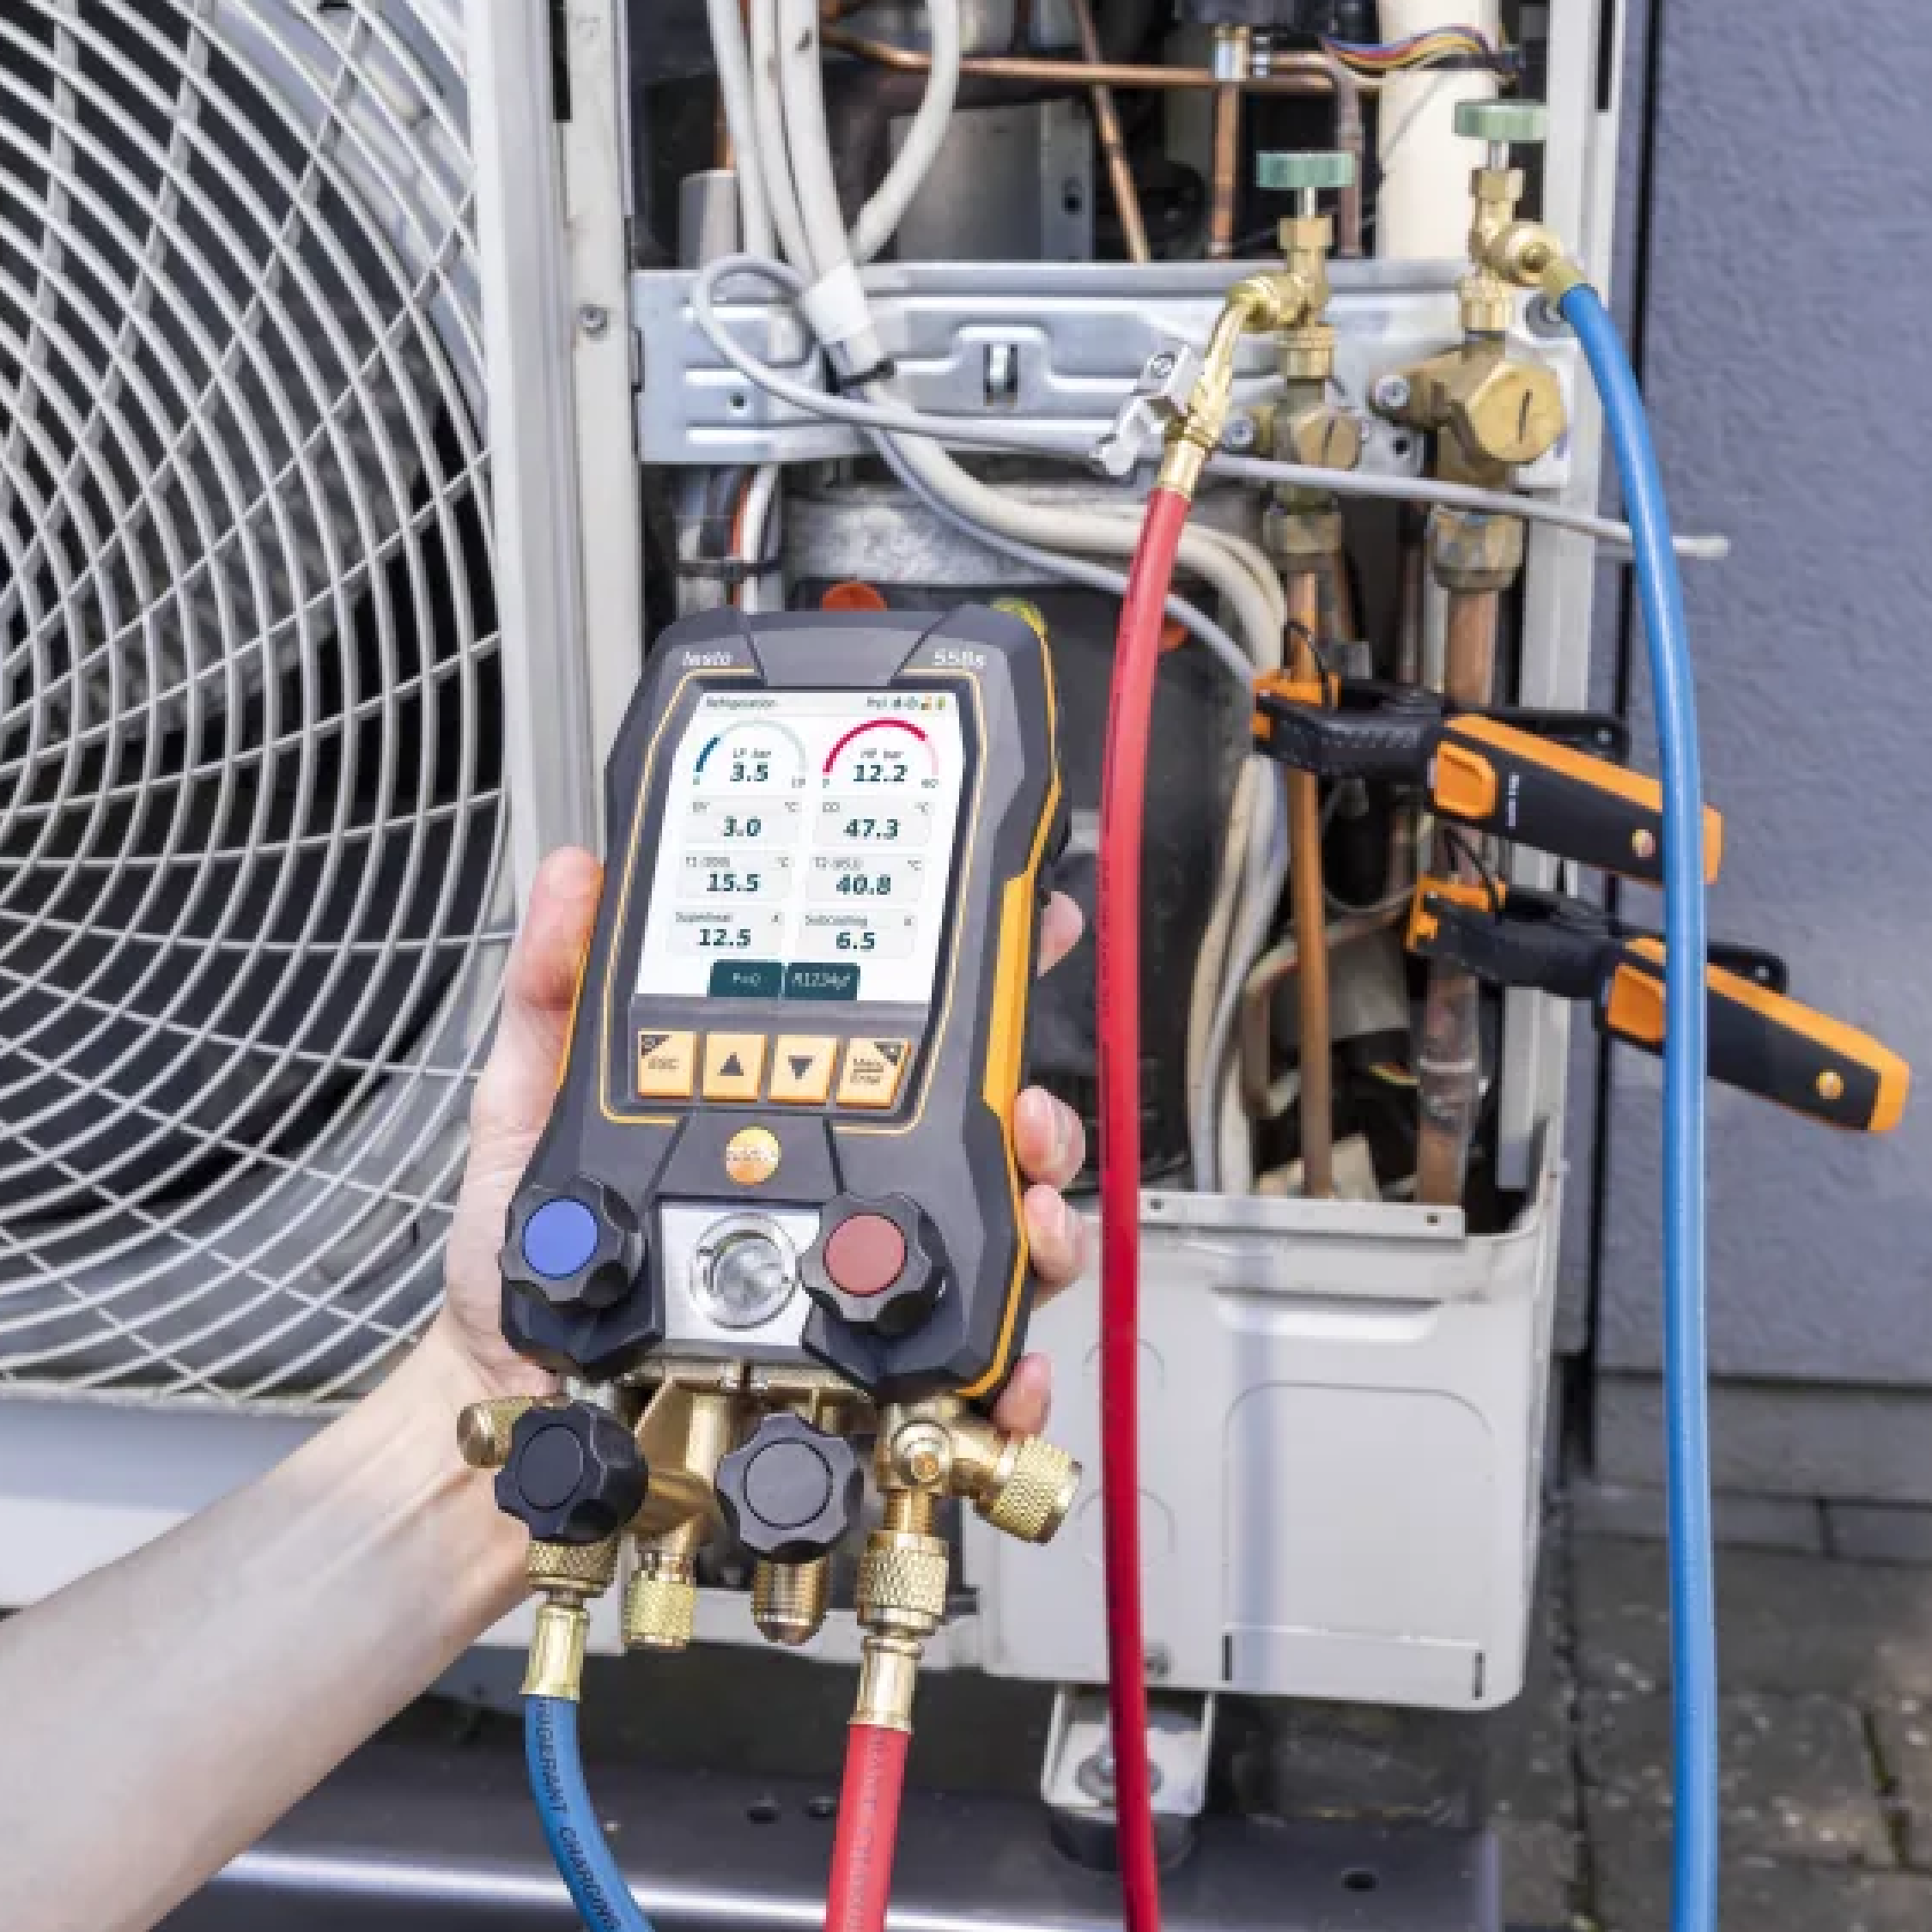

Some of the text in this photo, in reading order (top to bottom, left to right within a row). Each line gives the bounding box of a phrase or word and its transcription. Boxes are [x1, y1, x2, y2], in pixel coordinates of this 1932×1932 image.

[730, 762, 768, 781] 3.5
[854, 764, 908, 782] 12.2
[723, 816, 762, 837] 3.0
[843, 819, 900, 840] 47.3
[707, 872, 761, 892] 15.5
[835, 874, 891, 895] 40.8
[697, 929, 751, 947] 12.5
[835, 932, 876, 951] 6.5
